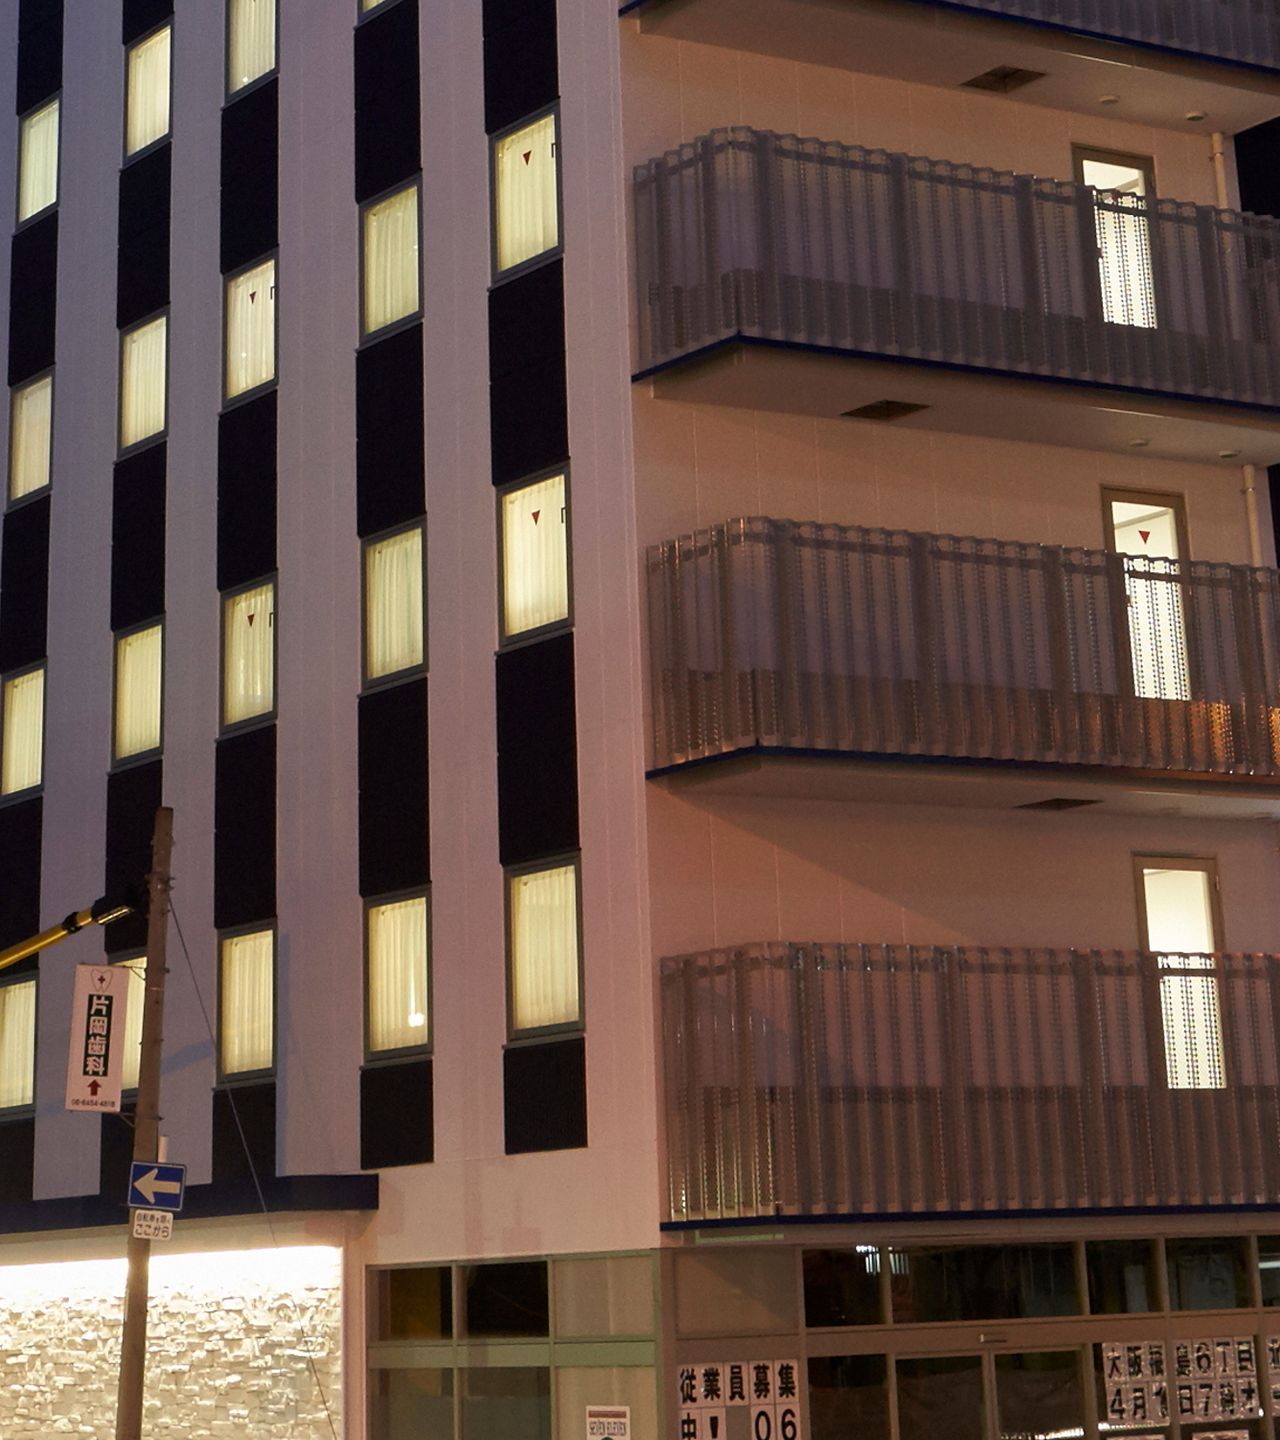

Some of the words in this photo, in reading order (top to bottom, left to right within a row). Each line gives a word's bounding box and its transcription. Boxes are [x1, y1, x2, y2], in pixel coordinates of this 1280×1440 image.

[85, 995, 111, 1076] 片岡歯科
[135, 1223, 170, 1239] ここから
[679, 1363, 797, 1405] 従業員募集
